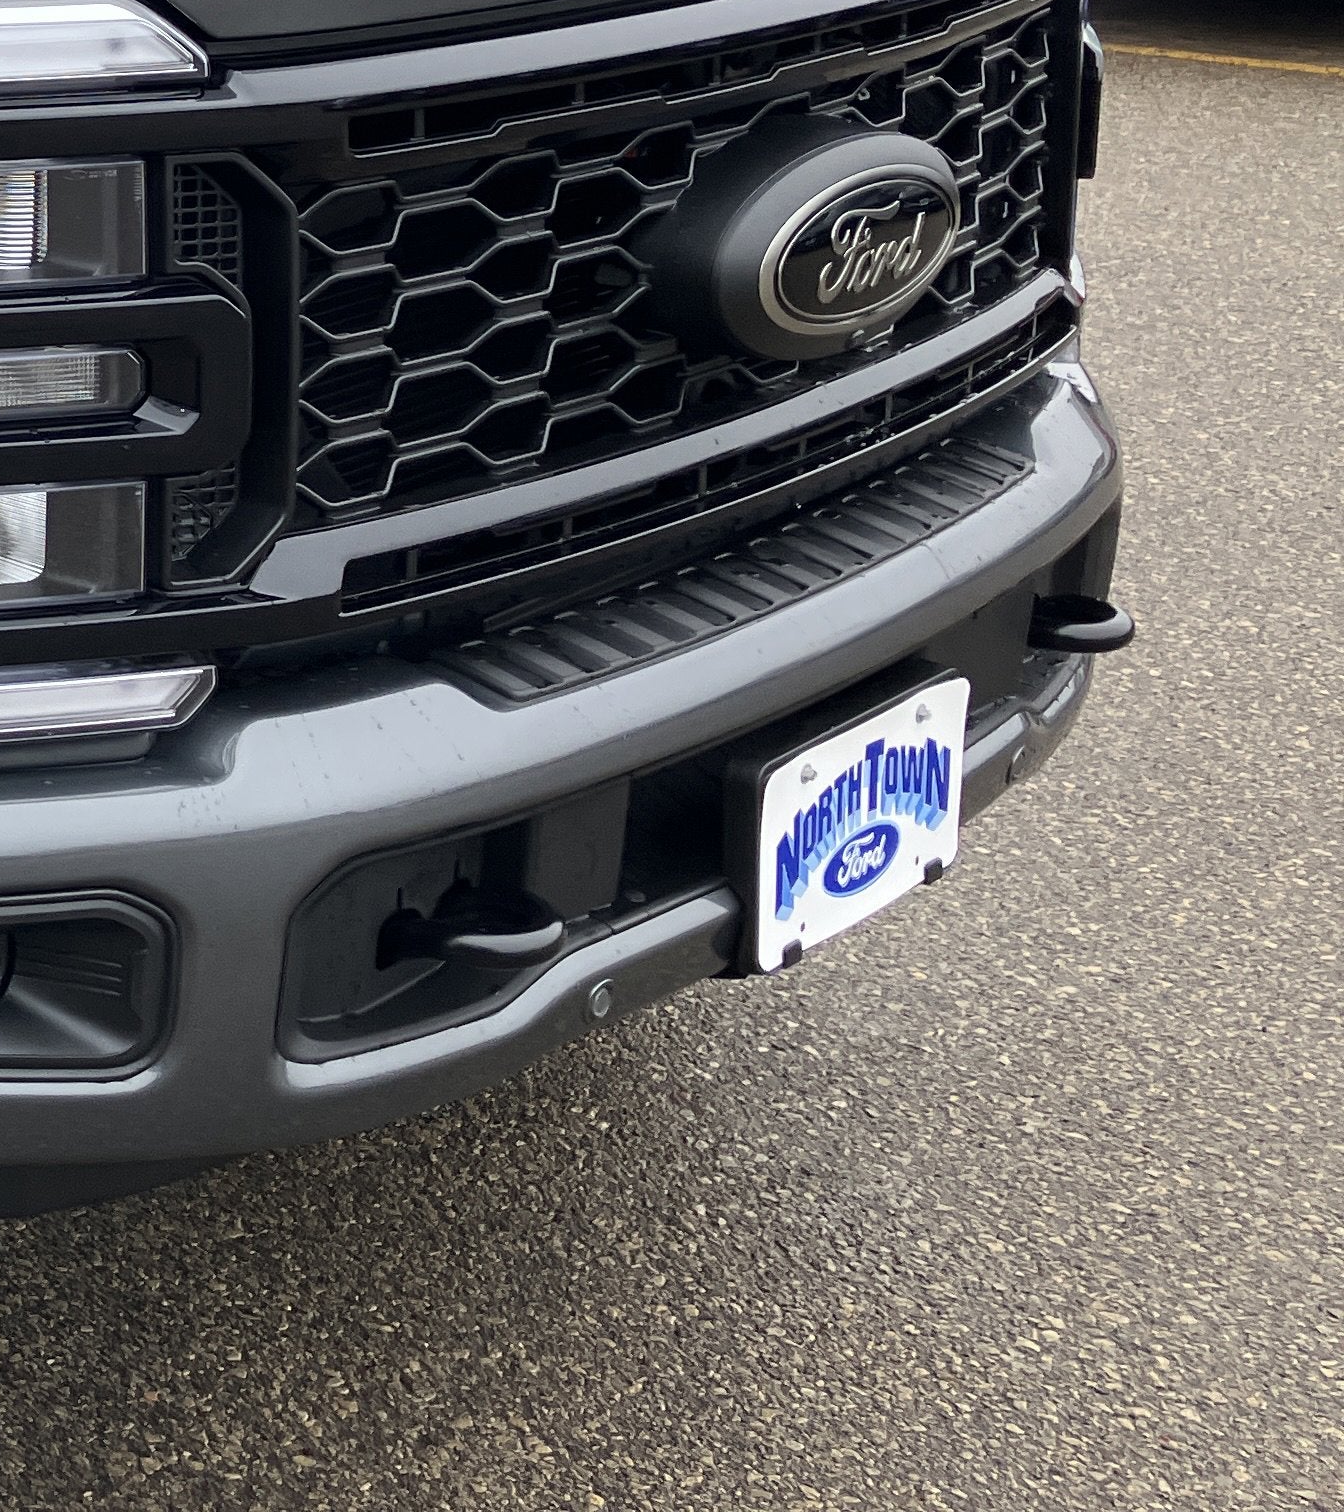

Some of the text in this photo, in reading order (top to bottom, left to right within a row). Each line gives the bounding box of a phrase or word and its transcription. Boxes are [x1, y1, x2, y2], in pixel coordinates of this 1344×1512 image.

[818, 202, 927, 306] Ford
[775, 737, 951, 919] NORTH TOWN
[837, 832, 887, 888] Ford
